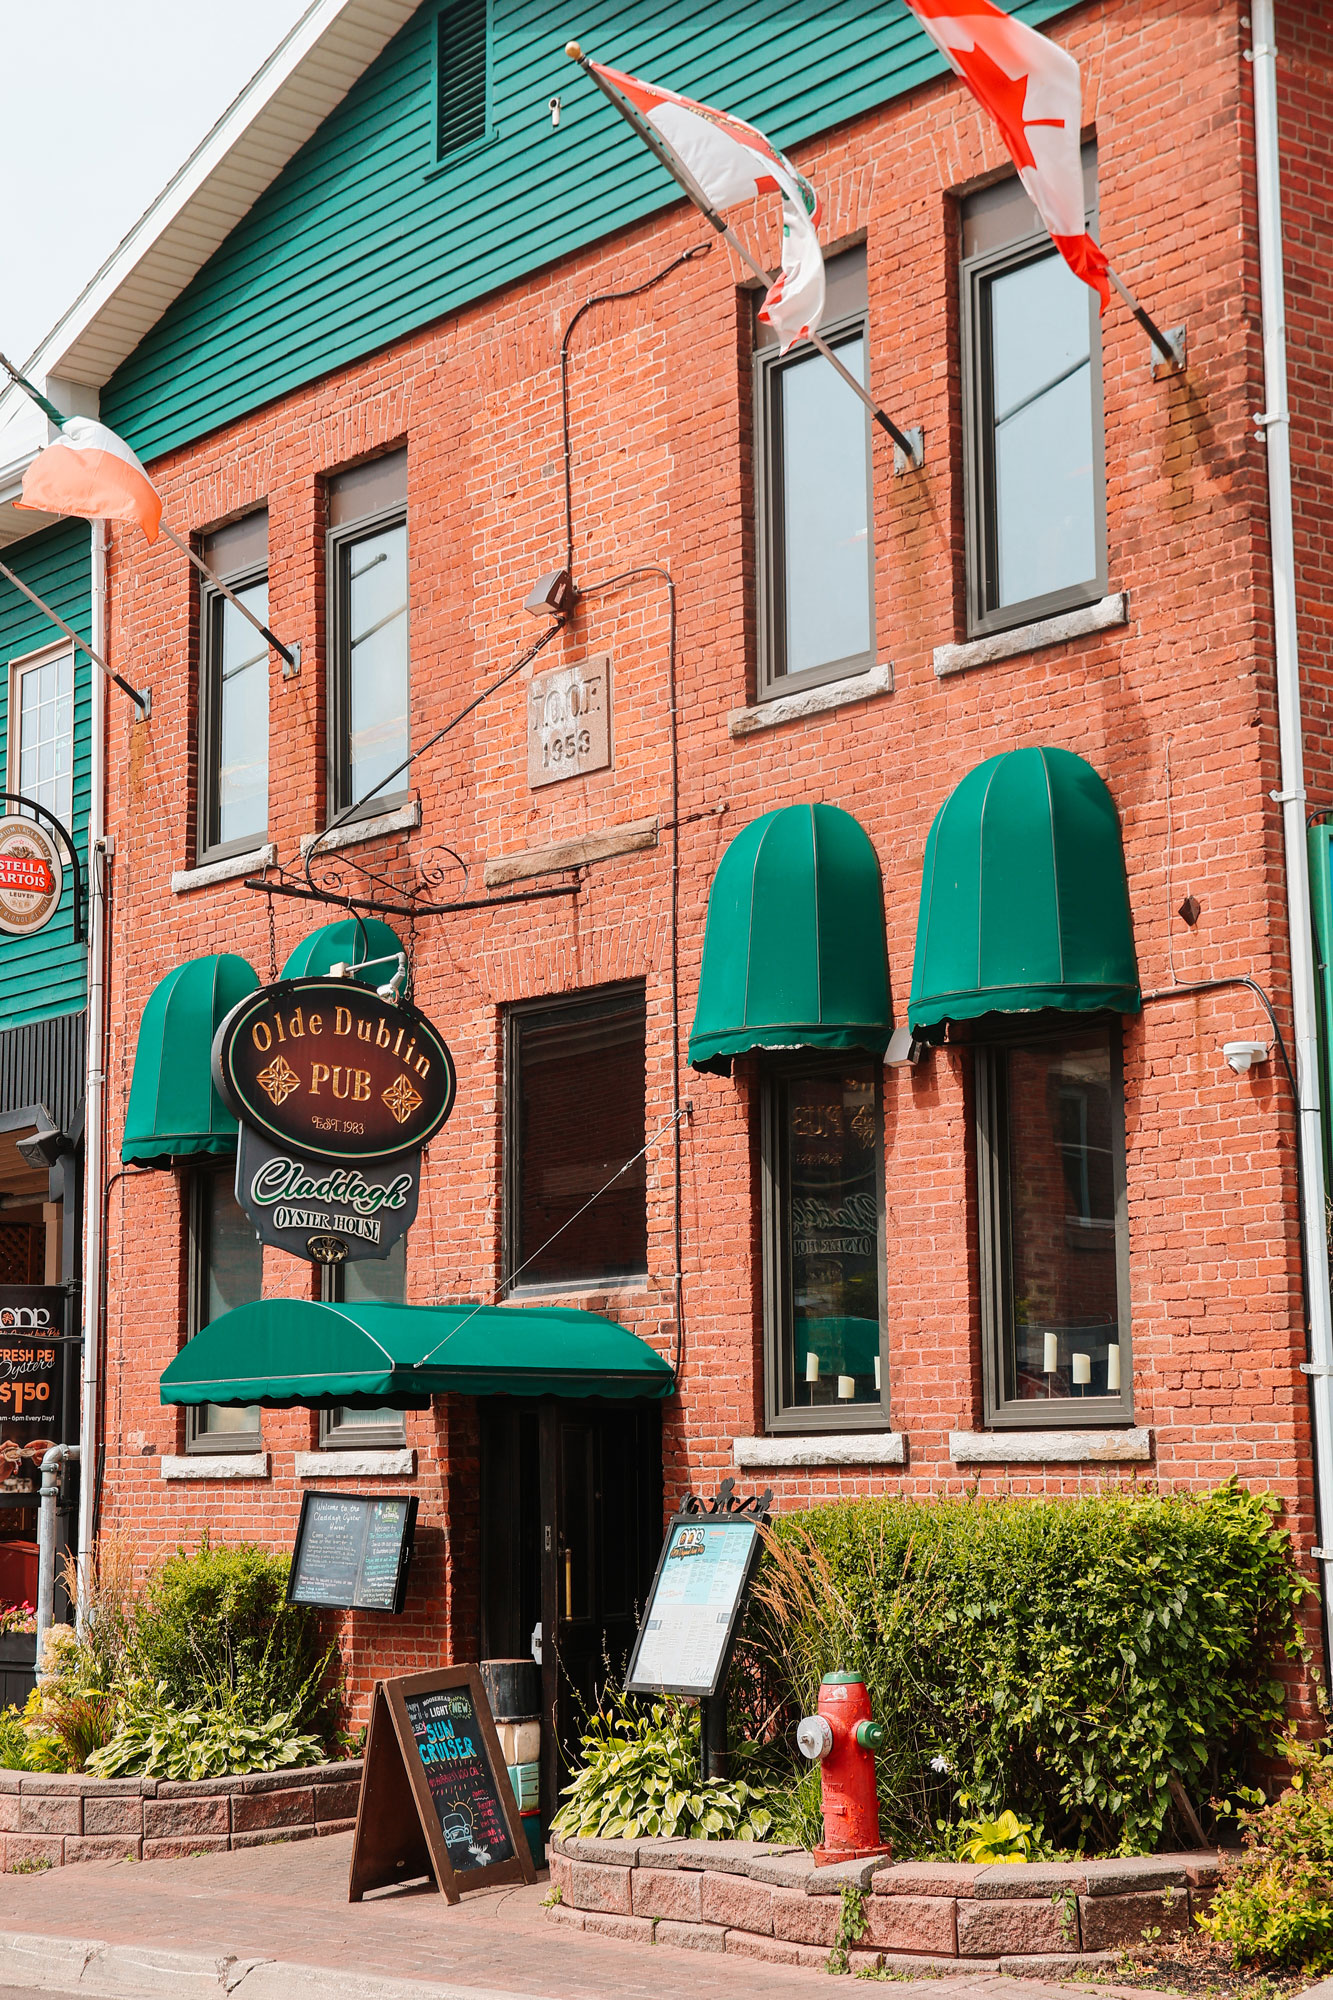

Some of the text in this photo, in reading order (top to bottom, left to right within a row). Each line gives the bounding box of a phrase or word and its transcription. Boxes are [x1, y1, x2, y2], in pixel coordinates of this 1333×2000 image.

[0, 860, 46, 876] STELLA
[0, 872, 46, 888] ARTOIS
[9, 891, 35, 899] LEUVEN
[251, 1005, 432, 1081] Olde Dublin
[308, 1061, 372, 1102] PUB
[343, 1120, 365, 1135] 1983
[251, 1156, 413, 1216] Claddagh
[273, 1206, 381, 1244] OYSTER HOUSE
[340, 1503, 349, 1512] to
[429, 1704, 449, 1718] LIGHT
[451, 1701, 468, 1713] NEW
[426, 1719, 456, 1744] SUN
[418, 1736, 478, 1765] CRUISER
